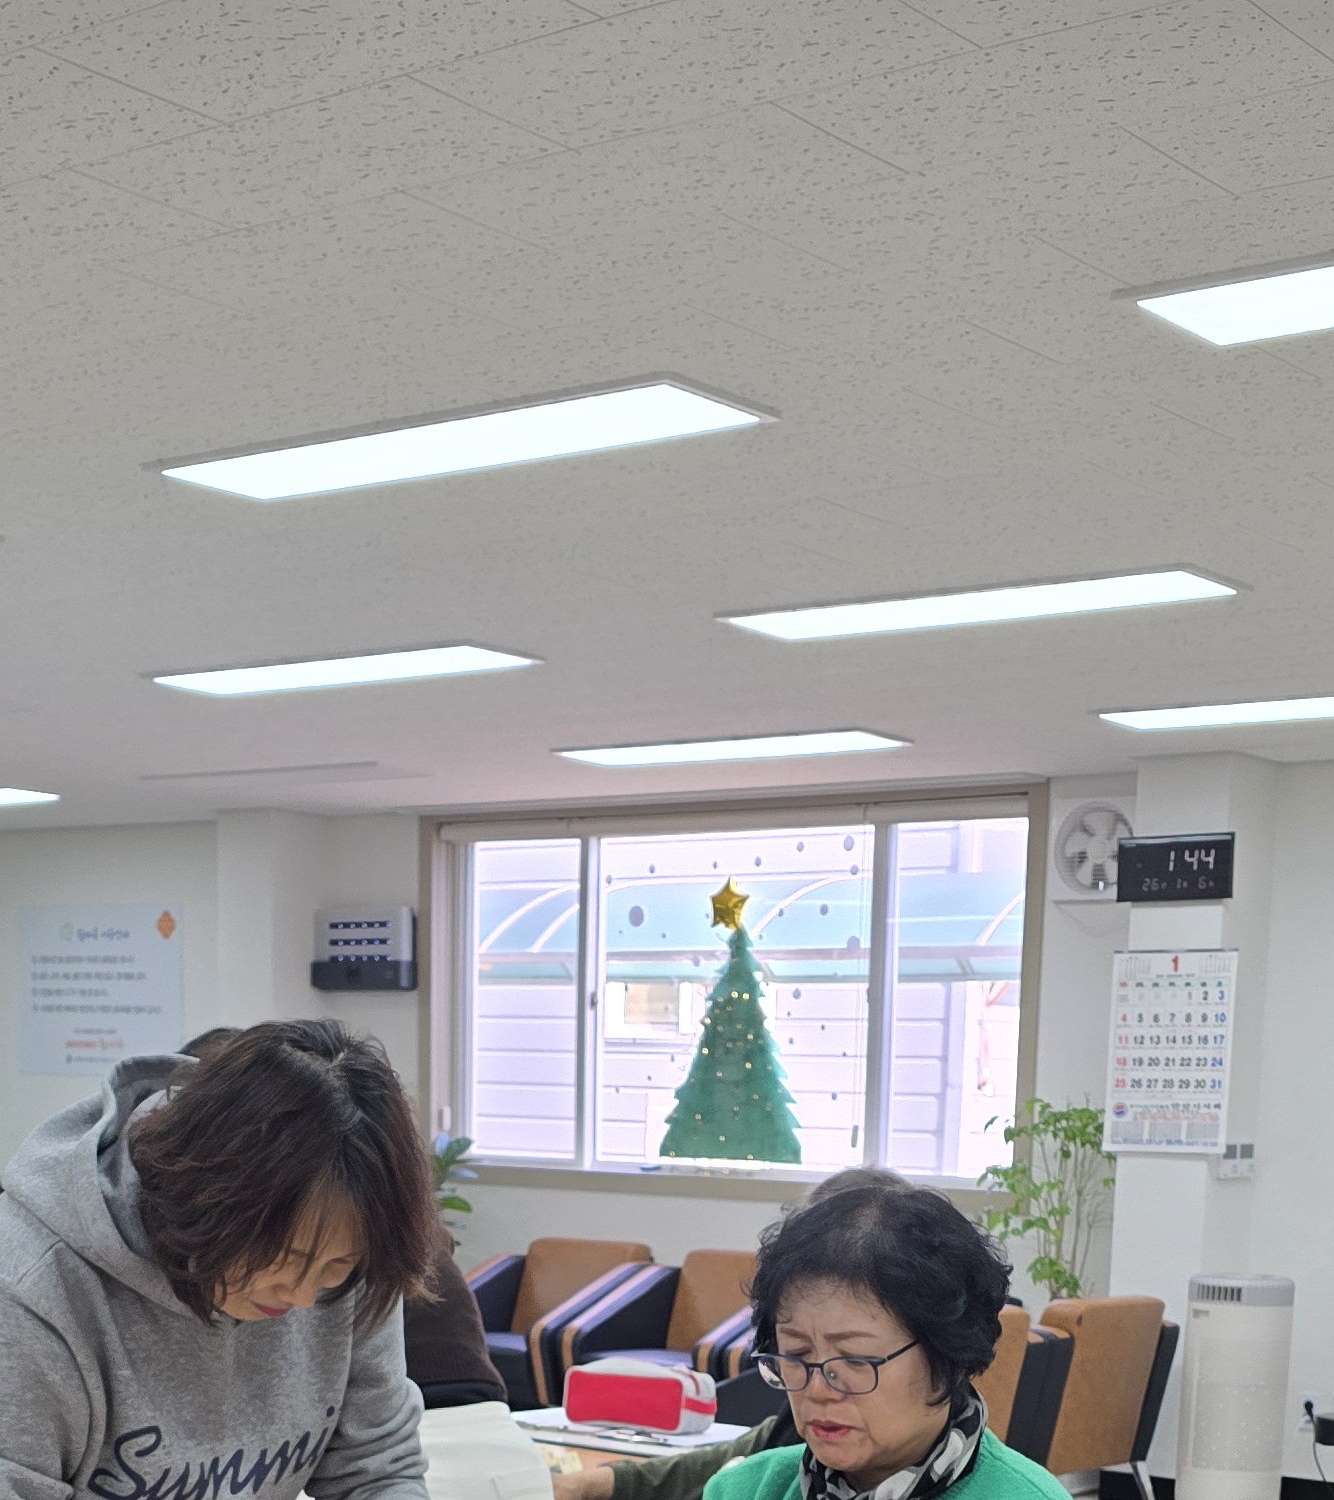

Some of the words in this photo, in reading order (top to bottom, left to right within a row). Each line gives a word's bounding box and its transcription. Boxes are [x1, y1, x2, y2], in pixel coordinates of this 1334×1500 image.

[1171, 955, 1179, 972] 1
[1202, 990, 1209, 1000] 2
[1218, 990, 1225, 1000] 3
[1153, 1013, 1160, 1023] 6
[1169, 1013, 1176, 1023] 7
[1185, 1013, 1192, 1023] 8
[1201, 1013, 1208, 1023] 9
[1214, 1013, 1226, 1023] 10
[1134, 1035, 1145, 1045] 12
[1149, 1035, 1160, 1045] 13
[1166, 1035, 1176, 1045] 14
[1182, 1035, 1193, 1045] 15
[1198, 1035, 1209, 1045] 16
[1213, 1035, 1225, 1045] 17
[1132, 1057, 1144, 1067] 19
[1147, 1057, 1160, 1067] 20
[1164, 1057, 1175, 1067] 21
[1179, 1057, 1192, 1067] 22
[1195, 1057, 1207, 1067] 23
[1211, 1057, 1223, 1067] 24
[1130, 1078, 1142, 1089] 26
[1146, 1078, 1158, 1089] 27
[1162, 1078, 1174, 1089] 28
[1178, 1078, 1190, 1089] 29
[1194, 1078, 1206, 1089] 30
[1210, 1078, 1222, 1089] 31
